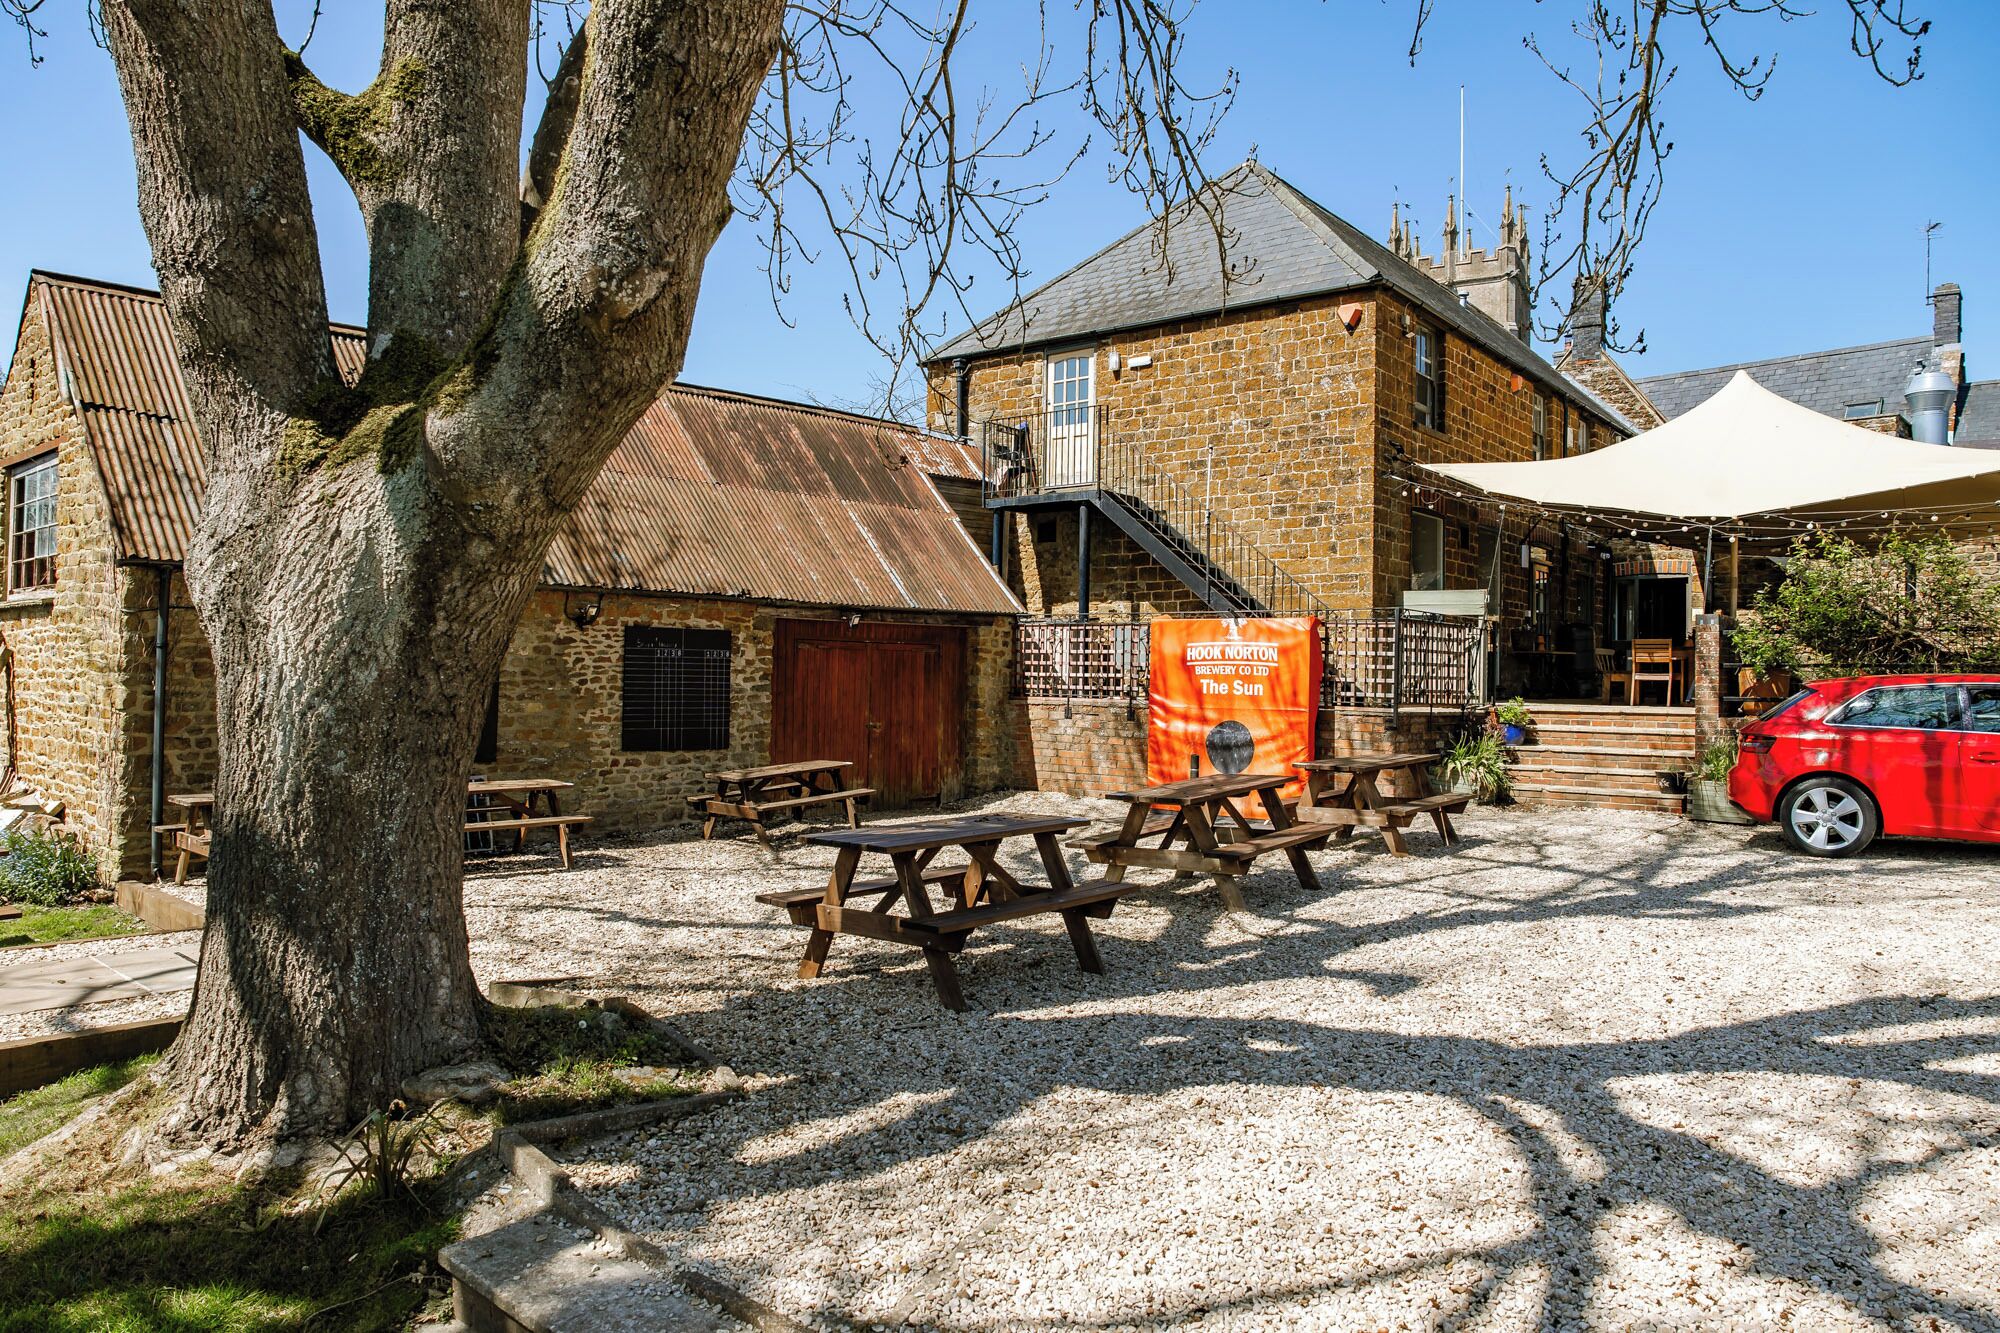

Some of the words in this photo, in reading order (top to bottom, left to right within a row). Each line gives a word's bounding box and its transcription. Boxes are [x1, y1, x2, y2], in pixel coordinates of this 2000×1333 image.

[1187, 646, 1223, 661] HOOK
[1225, 646, 1278, 661] NORTON
[1195, 665, 1237, 675] BREWERY
[1238, 665, 1251, 676] CO
[1253, 666, 1270, 676] LTD
[1200, 679, 1229, 695] The
[1232, 679, 1264, 696] Sun
